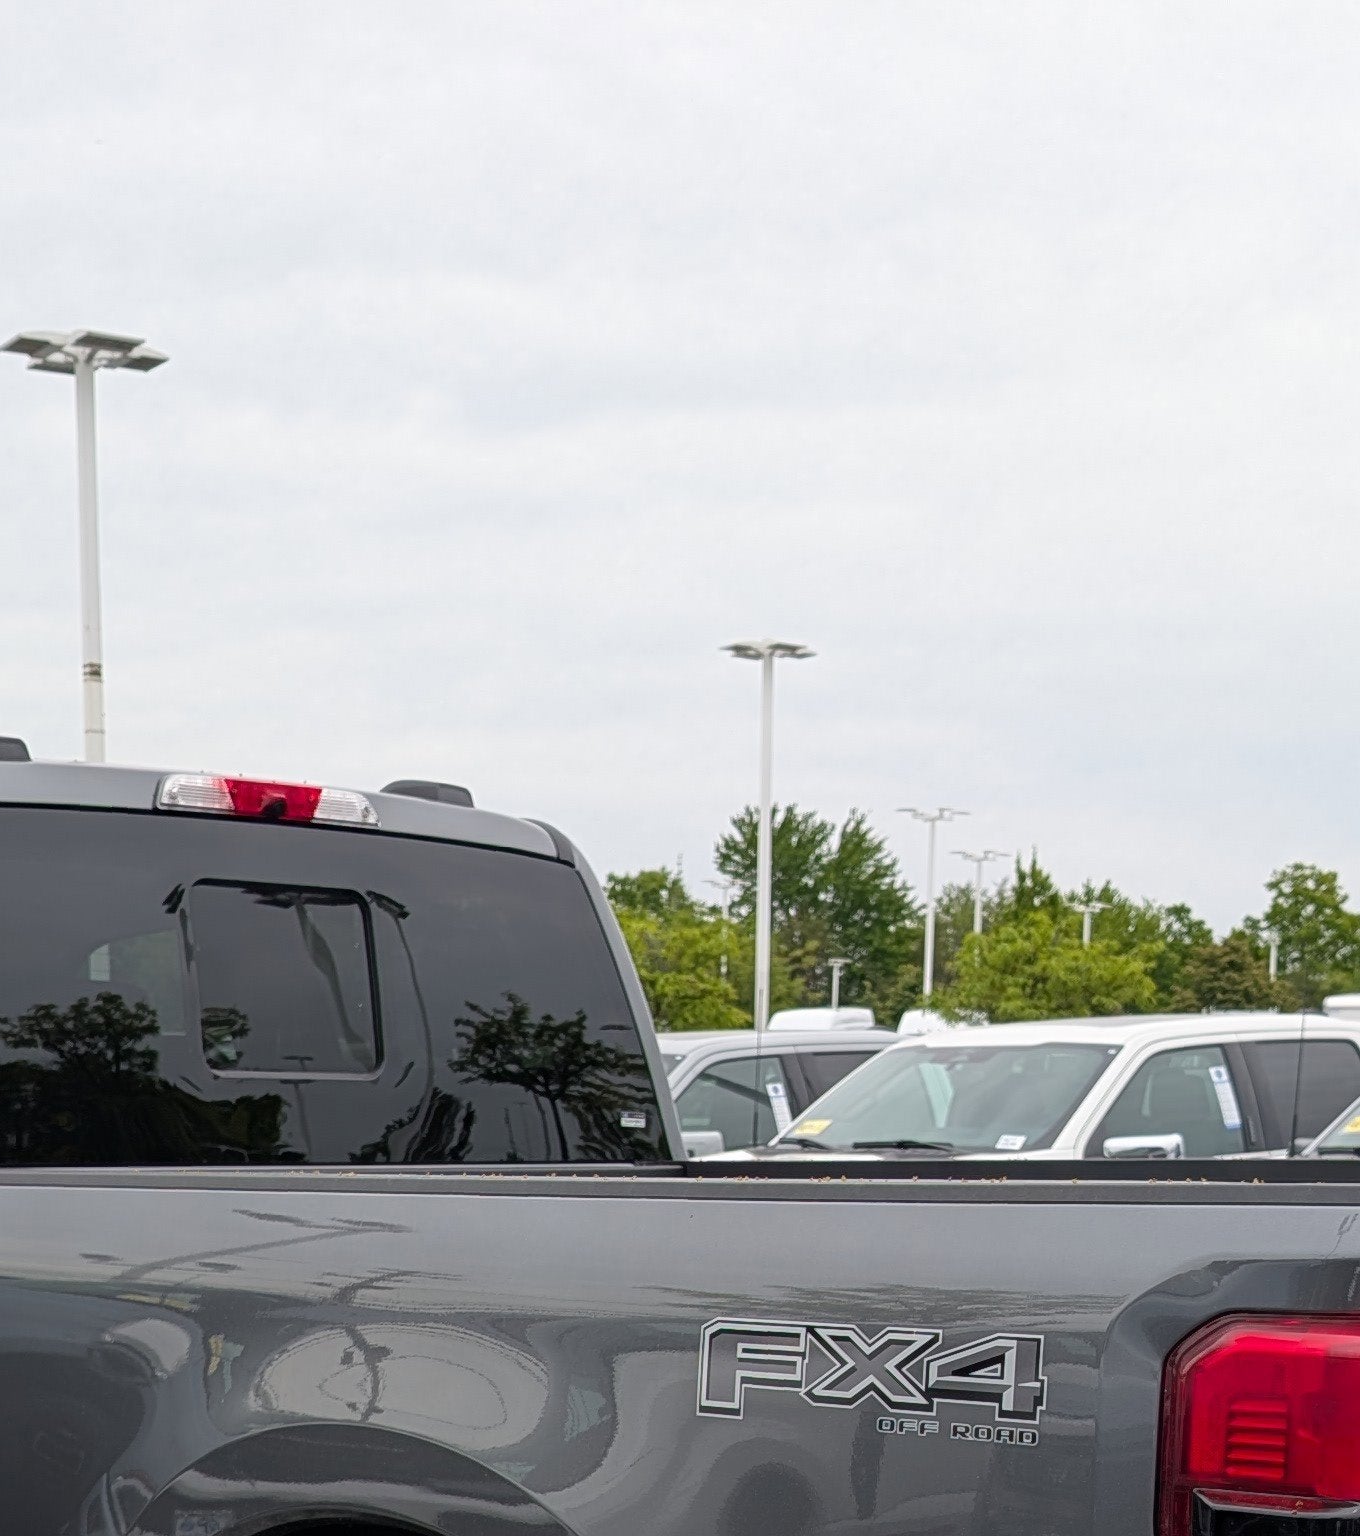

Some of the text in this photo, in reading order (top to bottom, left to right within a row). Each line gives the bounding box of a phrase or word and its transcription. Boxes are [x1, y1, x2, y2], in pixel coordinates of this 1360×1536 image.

[696, 1316, 1047, 1424] FX4
[876, 1416, 1039, 1446] OFF ROAD
